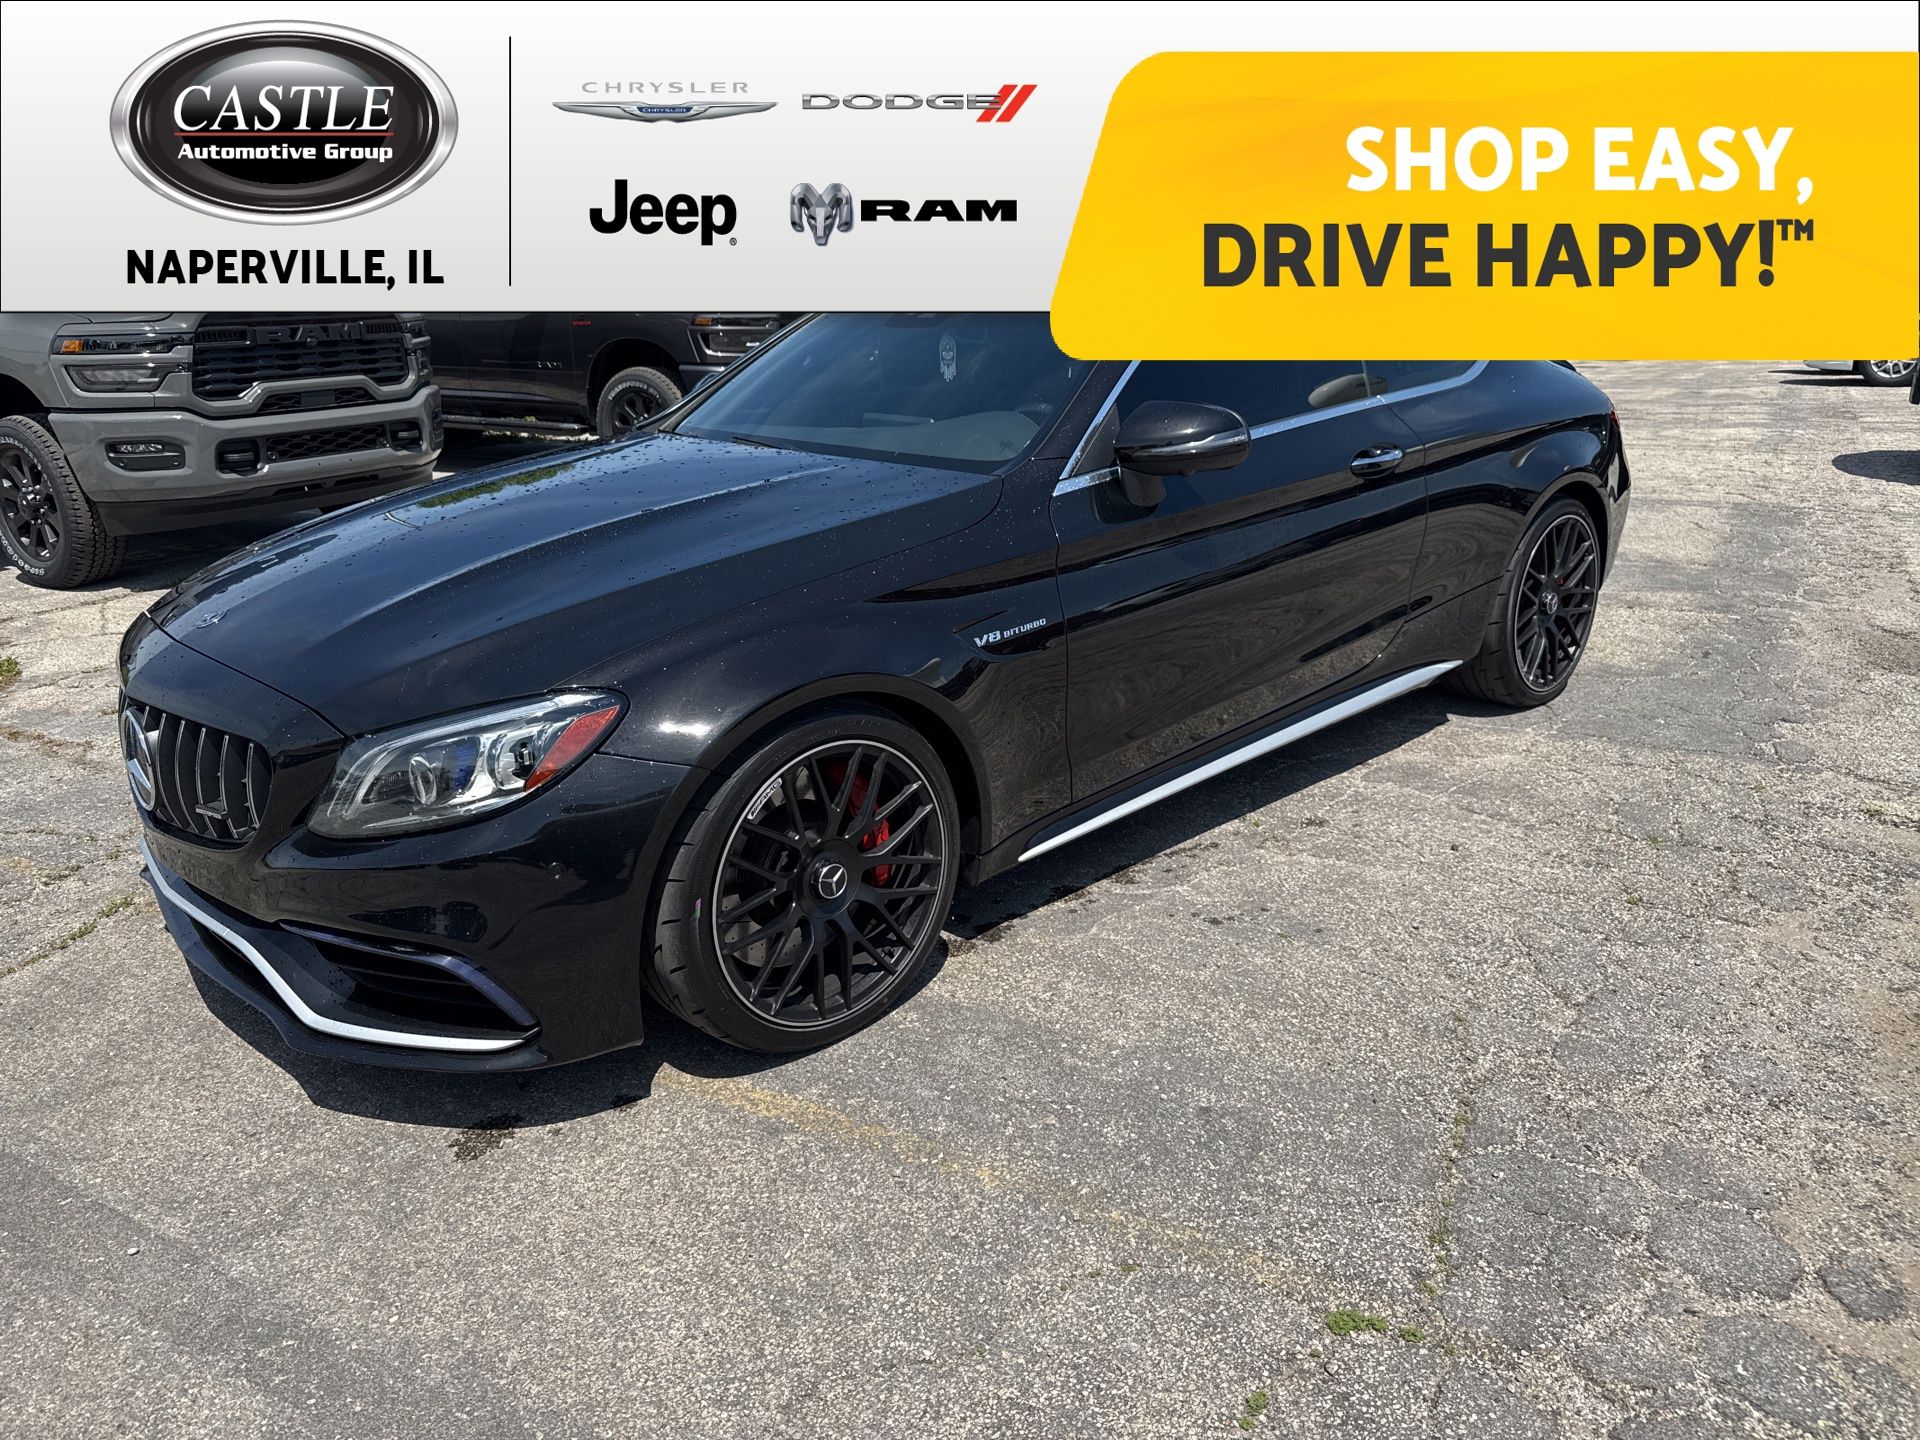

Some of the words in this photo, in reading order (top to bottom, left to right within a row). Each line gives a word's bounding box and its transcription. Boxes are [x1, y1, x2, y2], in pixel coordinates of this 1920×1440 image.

[255, 322, 364, 344] RAM
[973, 630, 1001, 648] V8
[1003, 618, 1047, 638] BITURBO
